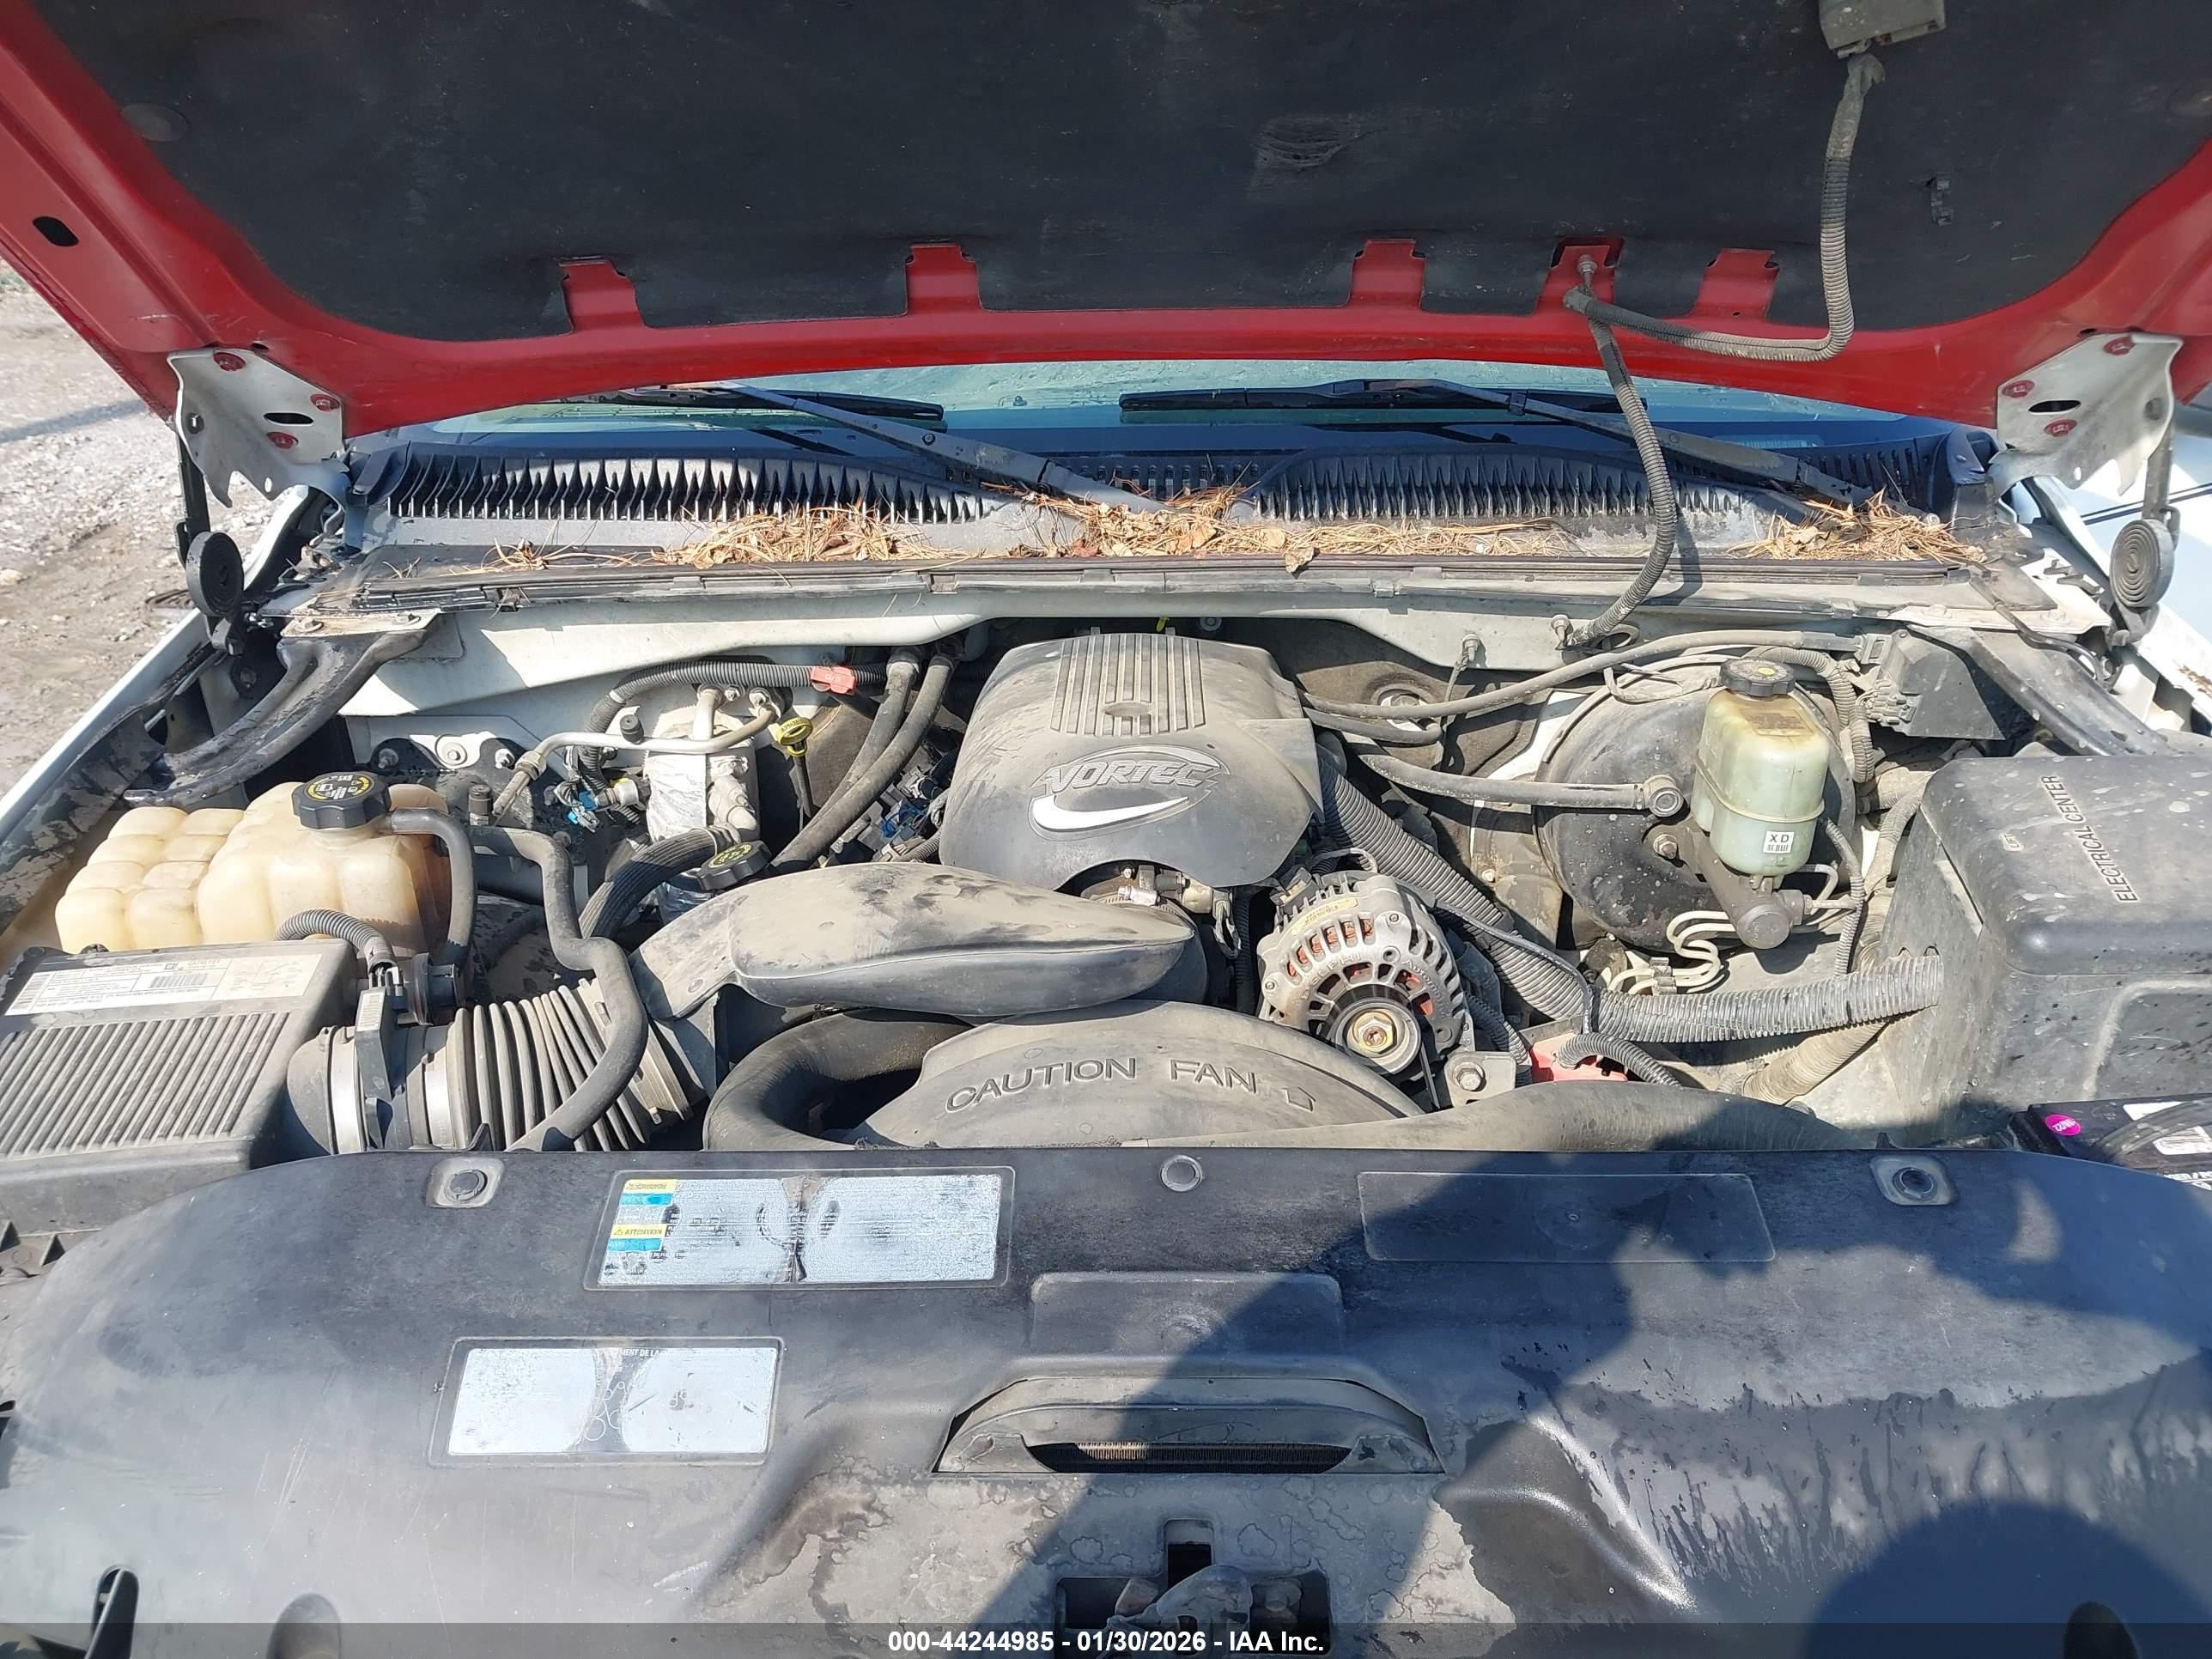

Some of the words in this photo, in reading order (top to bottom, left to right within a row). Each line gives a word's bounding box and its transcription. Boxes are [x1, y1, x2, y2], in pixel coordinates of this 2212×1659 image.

[1047, 759, 1215, 793] VORTEC
[2040, 775, 2084, 823] CENTER
[2073, 825, 2138, 902] ELECTRICAL
[945, 1057, 1137, 1113] CAUTION
[1170, 1058, 1258, 1095] FAN
